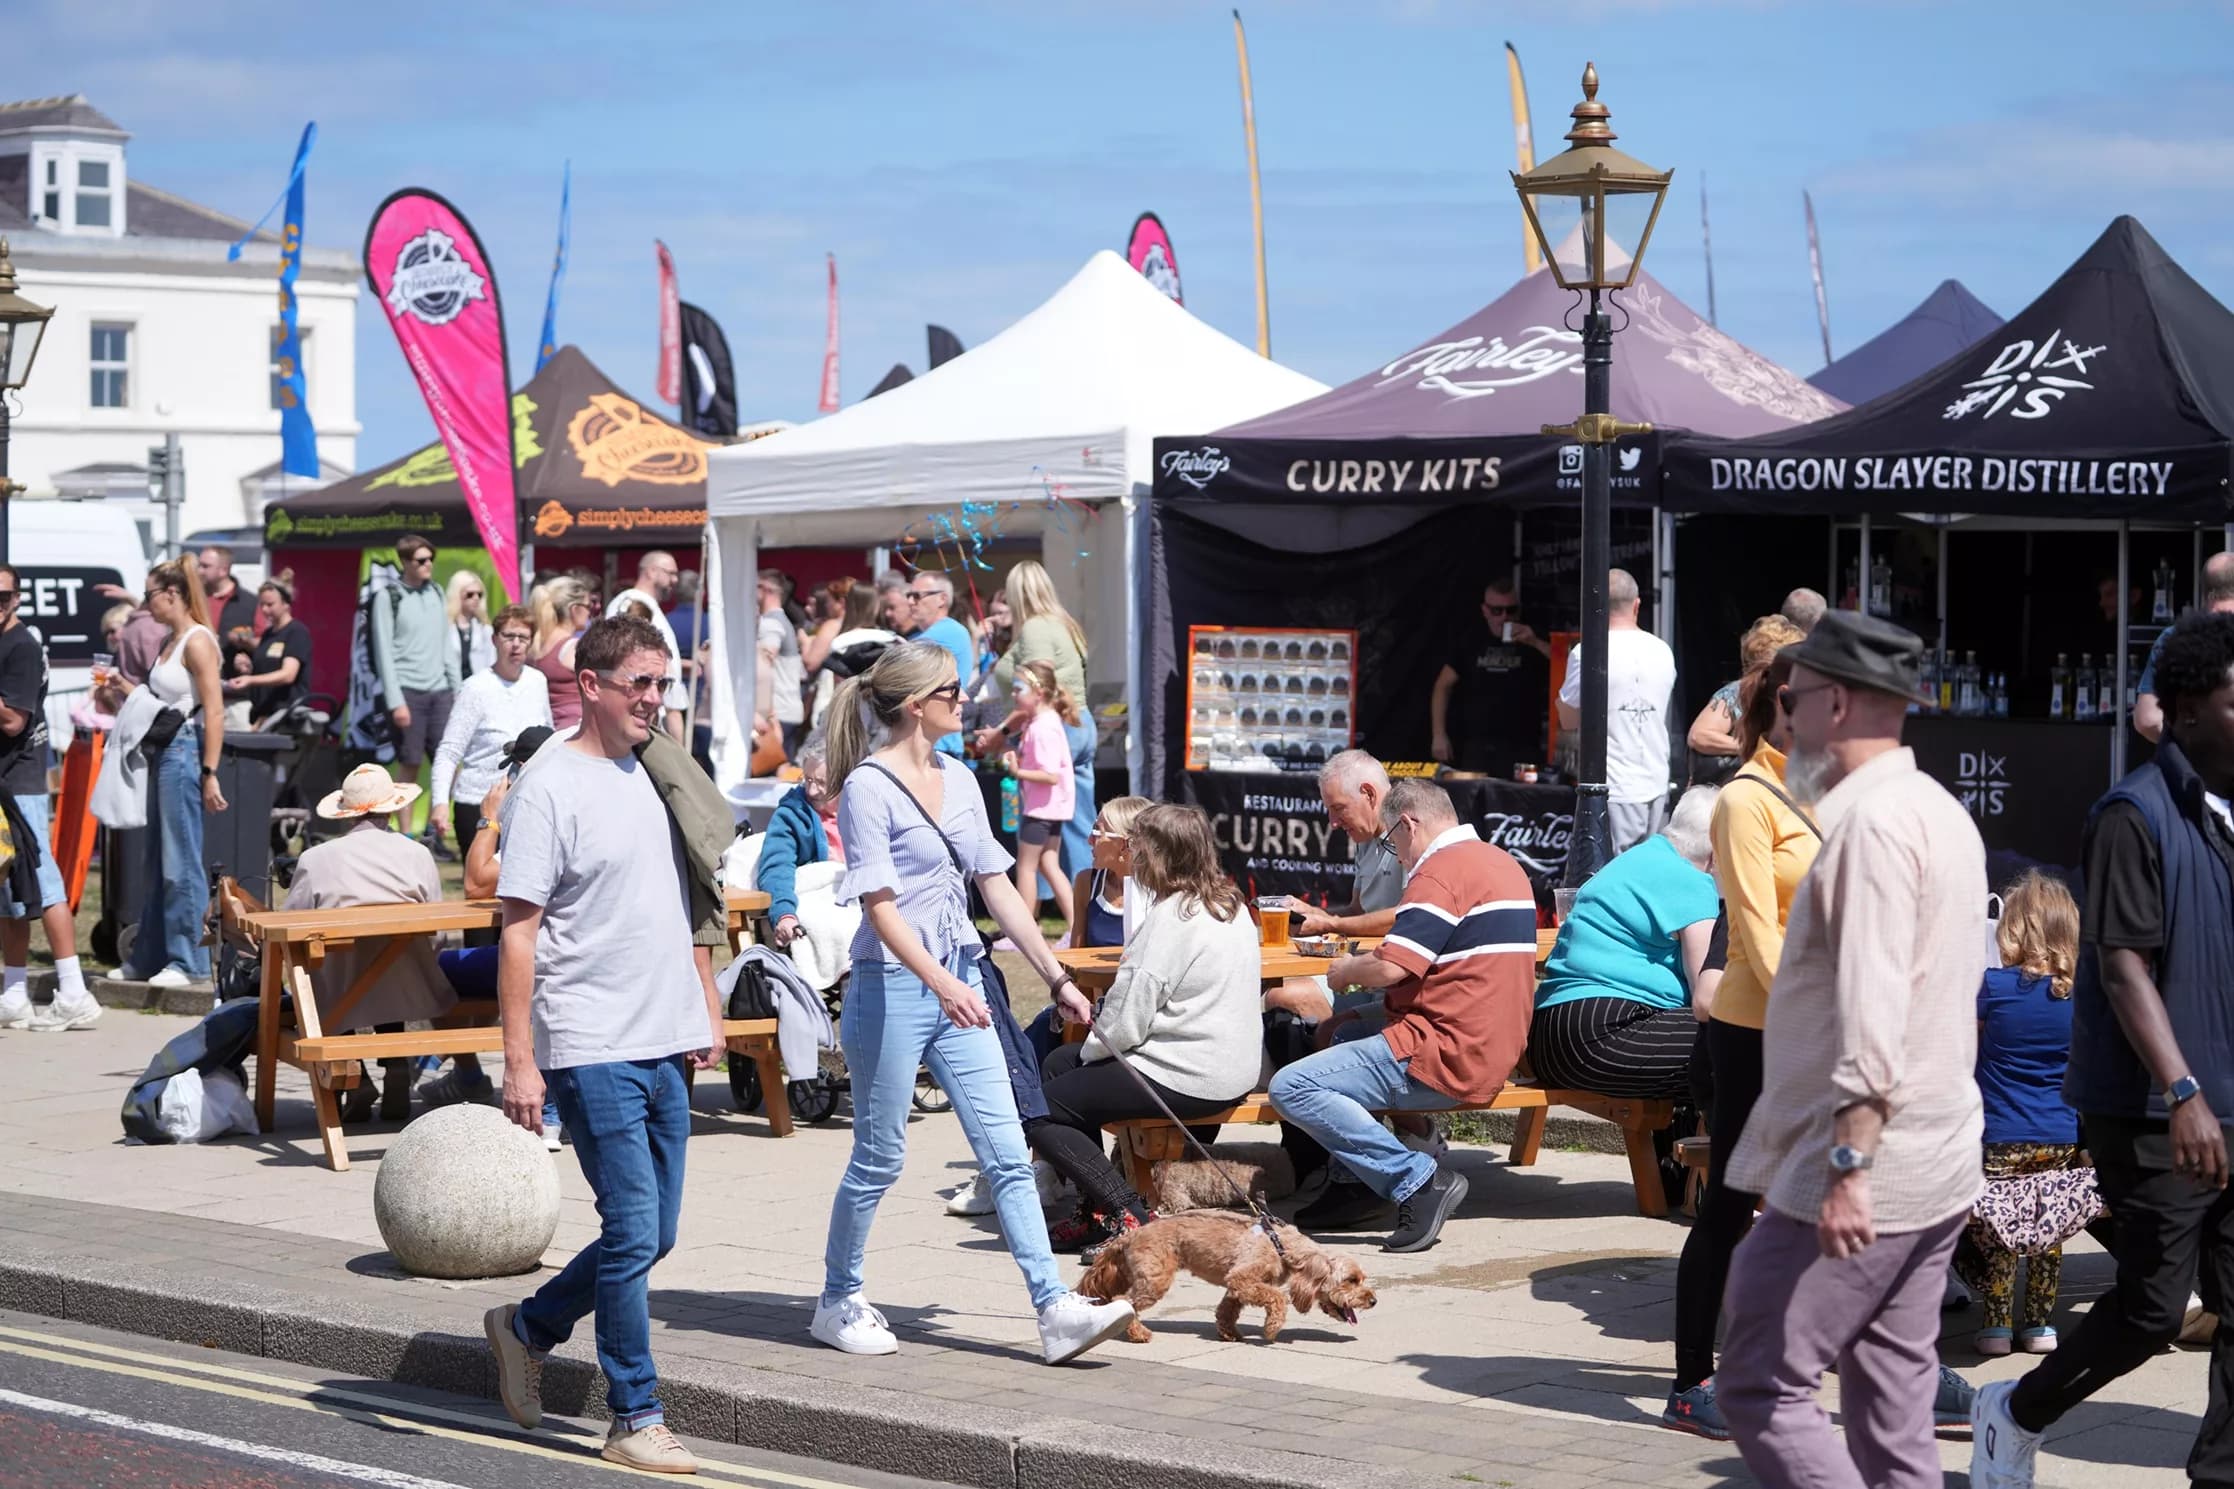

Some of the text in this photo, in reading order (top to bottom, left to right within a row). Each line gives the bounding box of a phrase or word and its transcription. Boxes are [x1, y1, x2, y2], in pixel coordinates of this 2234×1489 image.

[1374, 326, 1585, 406] Fairley
[1160, 446, 1231, 489] Fairley's
[1287, 457, 1502, 493] CURRY KITS
[1711, 456, 2174, 495] DRAGON SLAYER DISTILLERY
[1209, 812, 1333, 858] CURRY
[1272, 858, 1322, 875] COOKING
